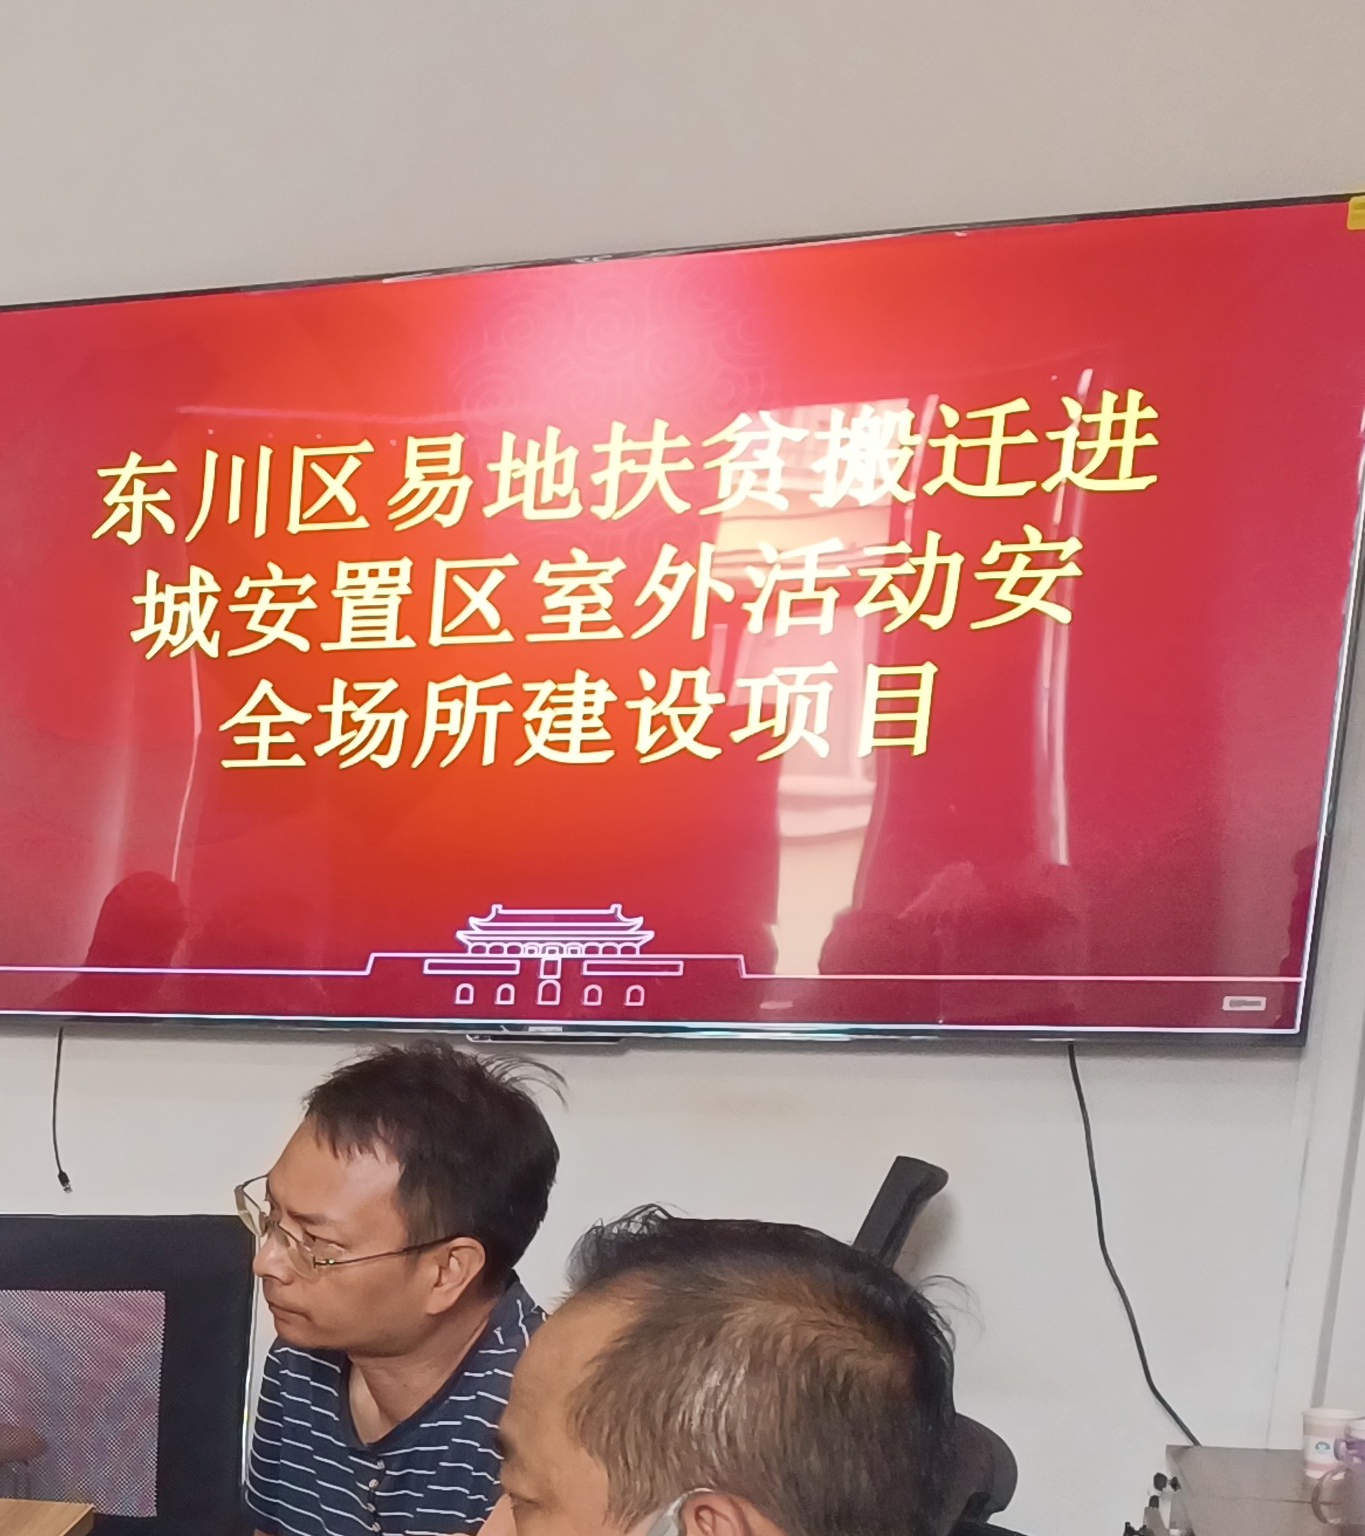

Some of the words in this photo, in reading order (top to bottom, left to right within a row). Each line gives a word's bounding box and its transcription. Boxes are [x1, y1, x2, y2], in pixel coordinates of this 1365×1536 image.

[91, 389, 1160, 546] 东川区易地扶贫搬迁进
[130, 524, 1084, 661] 城安置区室外活动安
[218, 661, 939, 771] 全场所建设项目
